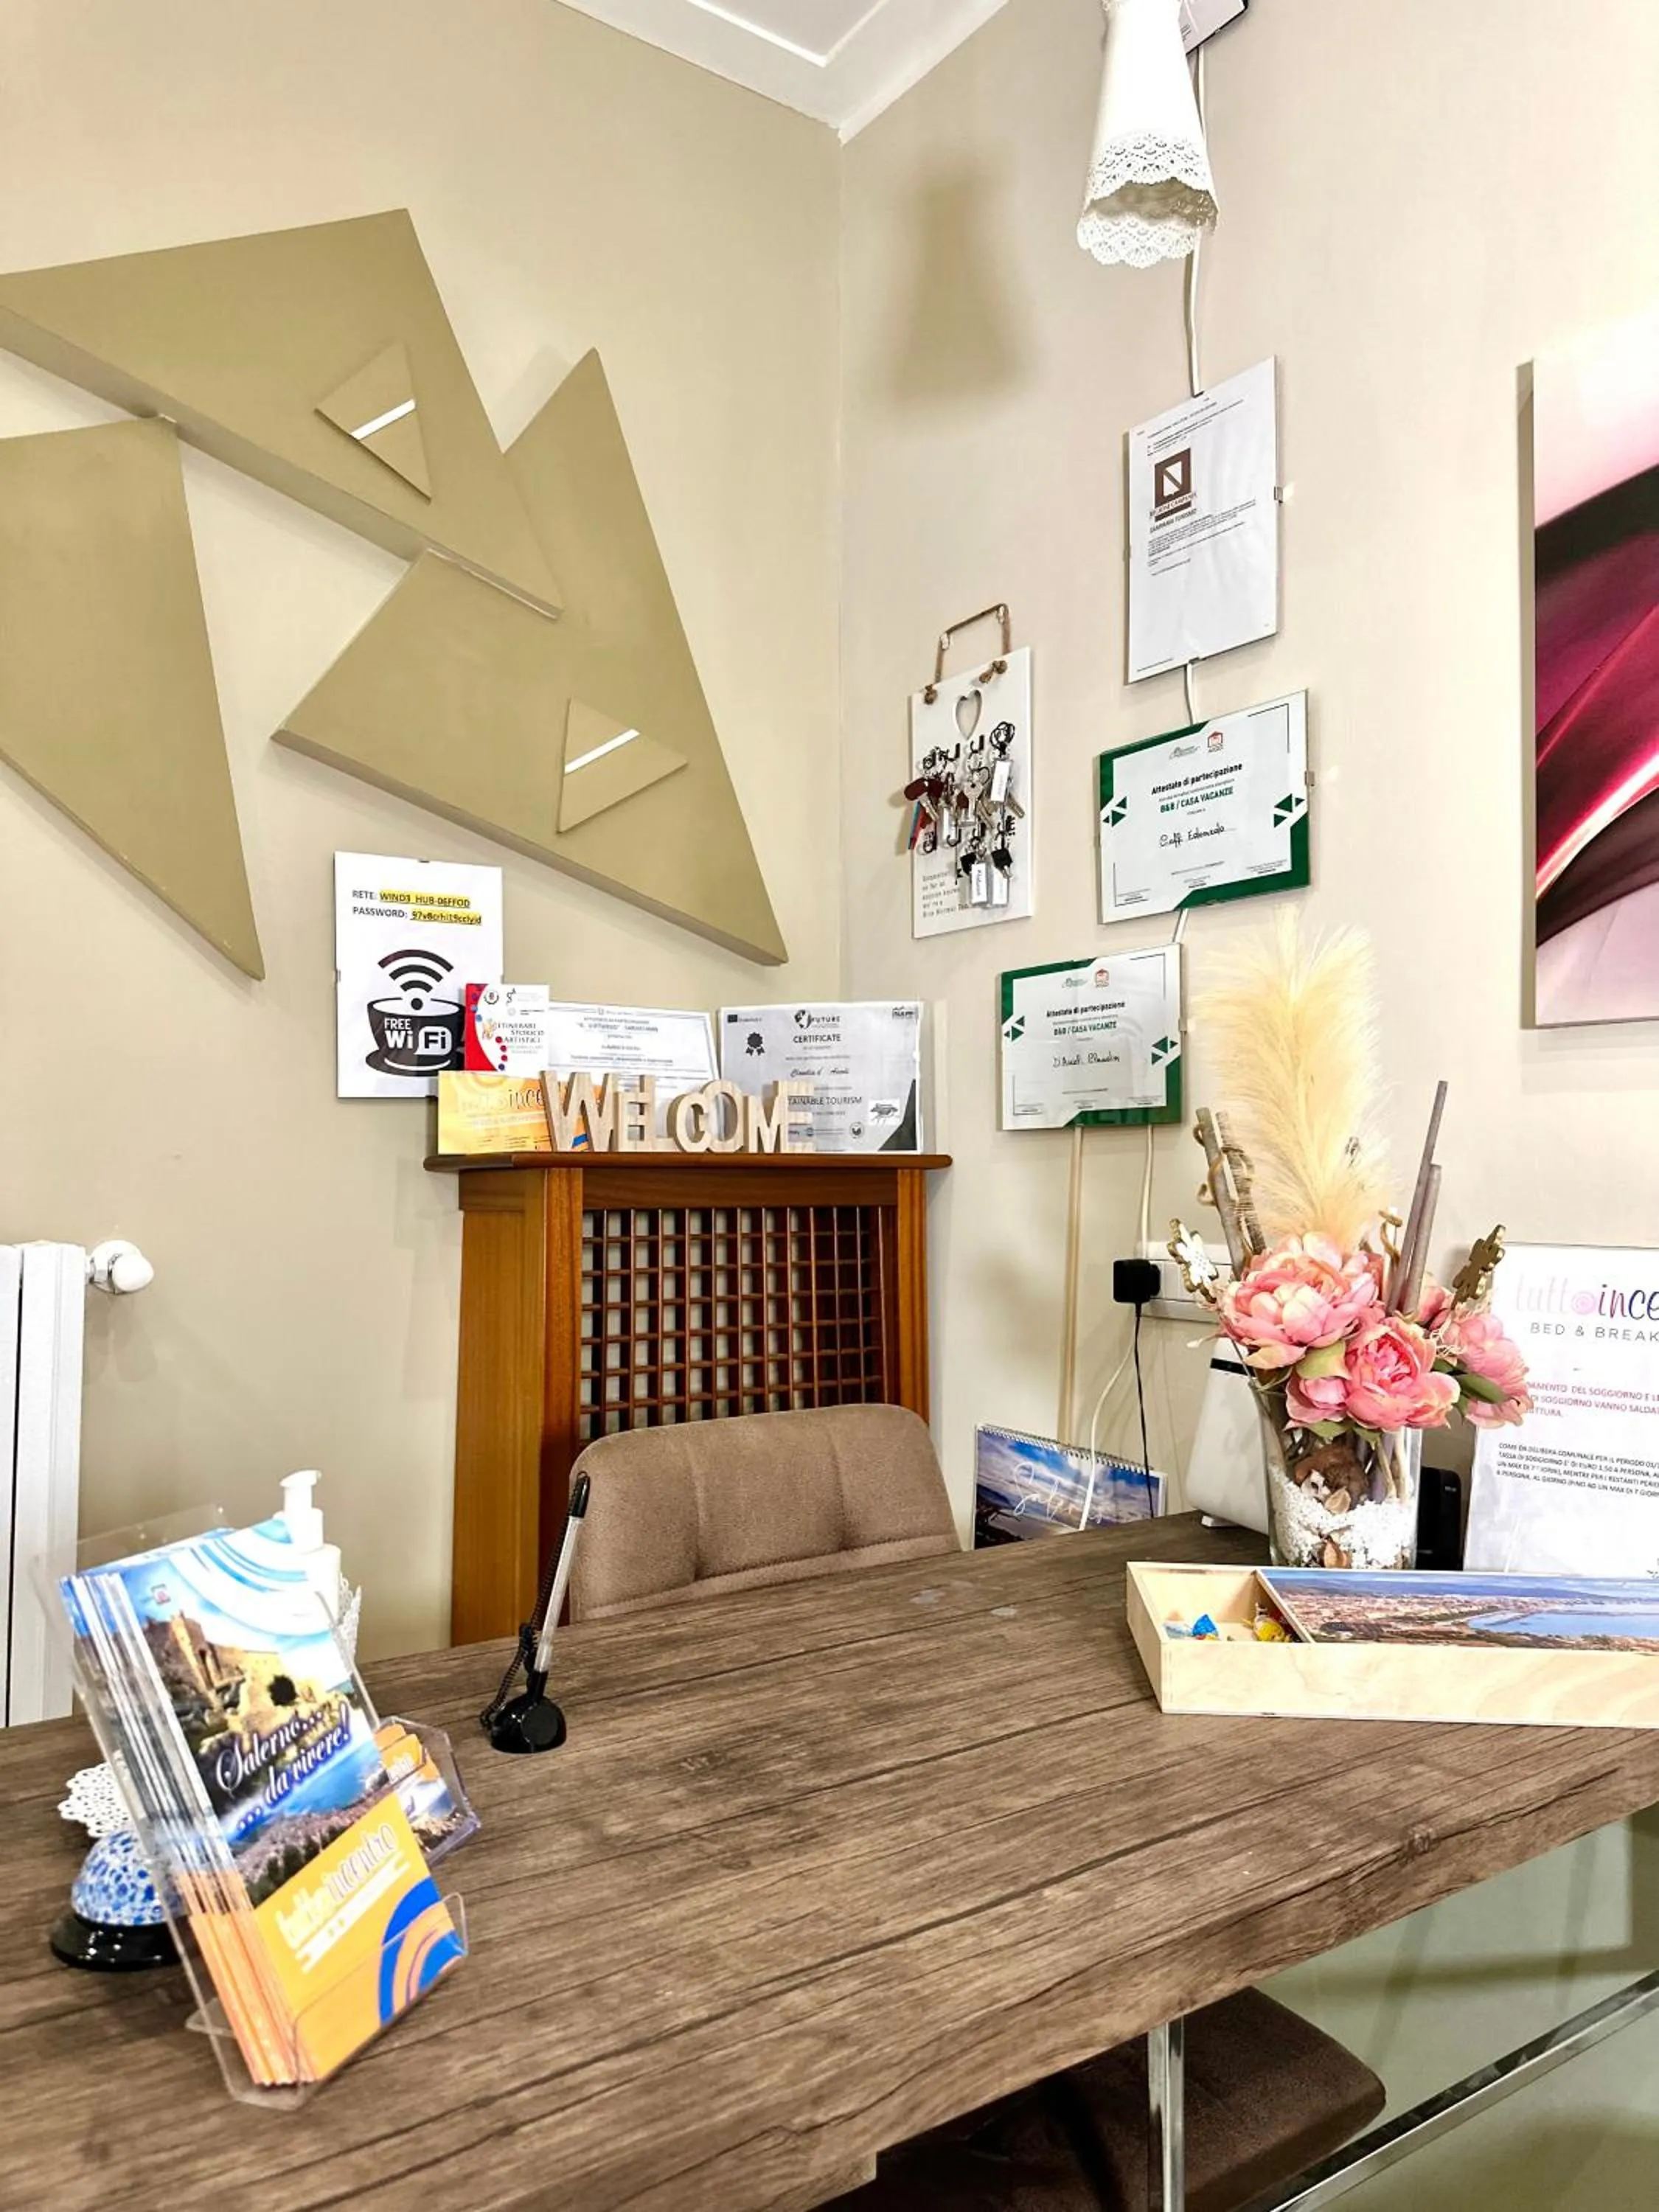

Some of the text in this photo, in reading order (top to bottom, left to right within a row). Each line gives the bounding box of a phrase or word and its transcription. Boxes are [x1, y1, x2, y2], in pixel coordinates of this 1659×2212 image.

[1152, 782, 1181, 795] Attestato
[1191, 763, 1242, 785] partecipazione
[1180, 796, 1200, 807] CASA
[1200, 786, 1233, 801] VACANZE
[352, 906, 408, 919] PASSWORD:
[384, 1018, 412, 1030] FREE
[384, 1030, 446, 1048] Wi Fi
[793, 1034, 841, 1043] CERTIFICATE
[787, 1096, 824, 1105] TAINABLE
[540, 1071, 815, 1152] WELCOME
[1530, 1322, 1659, 1342] BED & BREAK
[1571, 1385, 1587, 1394] DEL
[1589, 1388, 1643, 1402] SOGGIORNO
[1541, 1397, 1592, 1408] SOGGIORNO
[1595, 1402, 1627, 1412] VANNO
[1629, 1405, 1659, 1414] SALDAT
[265, 1765, 290, 1804] da
